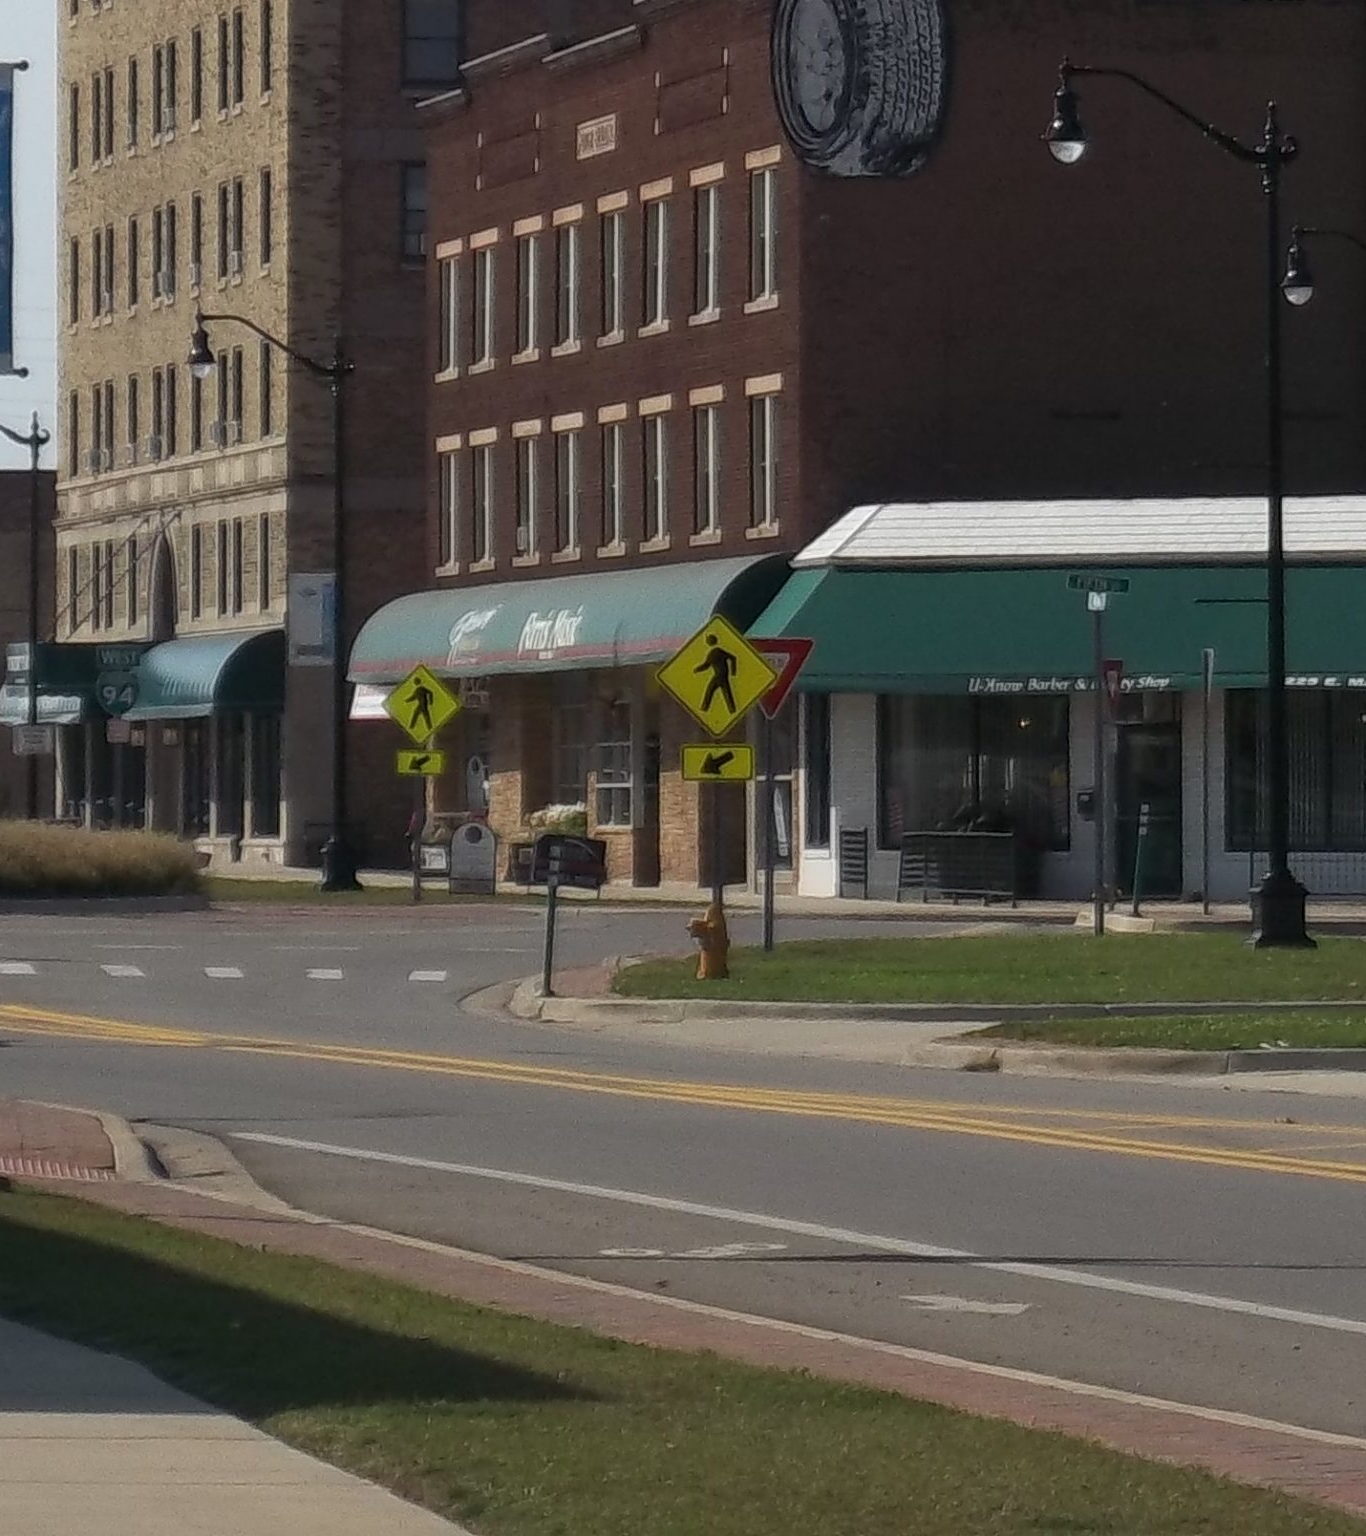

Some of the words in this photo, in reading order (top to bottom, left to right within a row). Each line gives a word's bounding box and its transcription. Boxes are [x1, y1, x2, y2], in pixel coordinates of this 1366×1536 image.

[101, 649, 137, 664] WEST
[1027, 677, 1070, 692] Barber
[1074, 677, 1086, 691] &
[1135, 675, 1170, 693] Shop
[102, 685, 133, 706] 94
